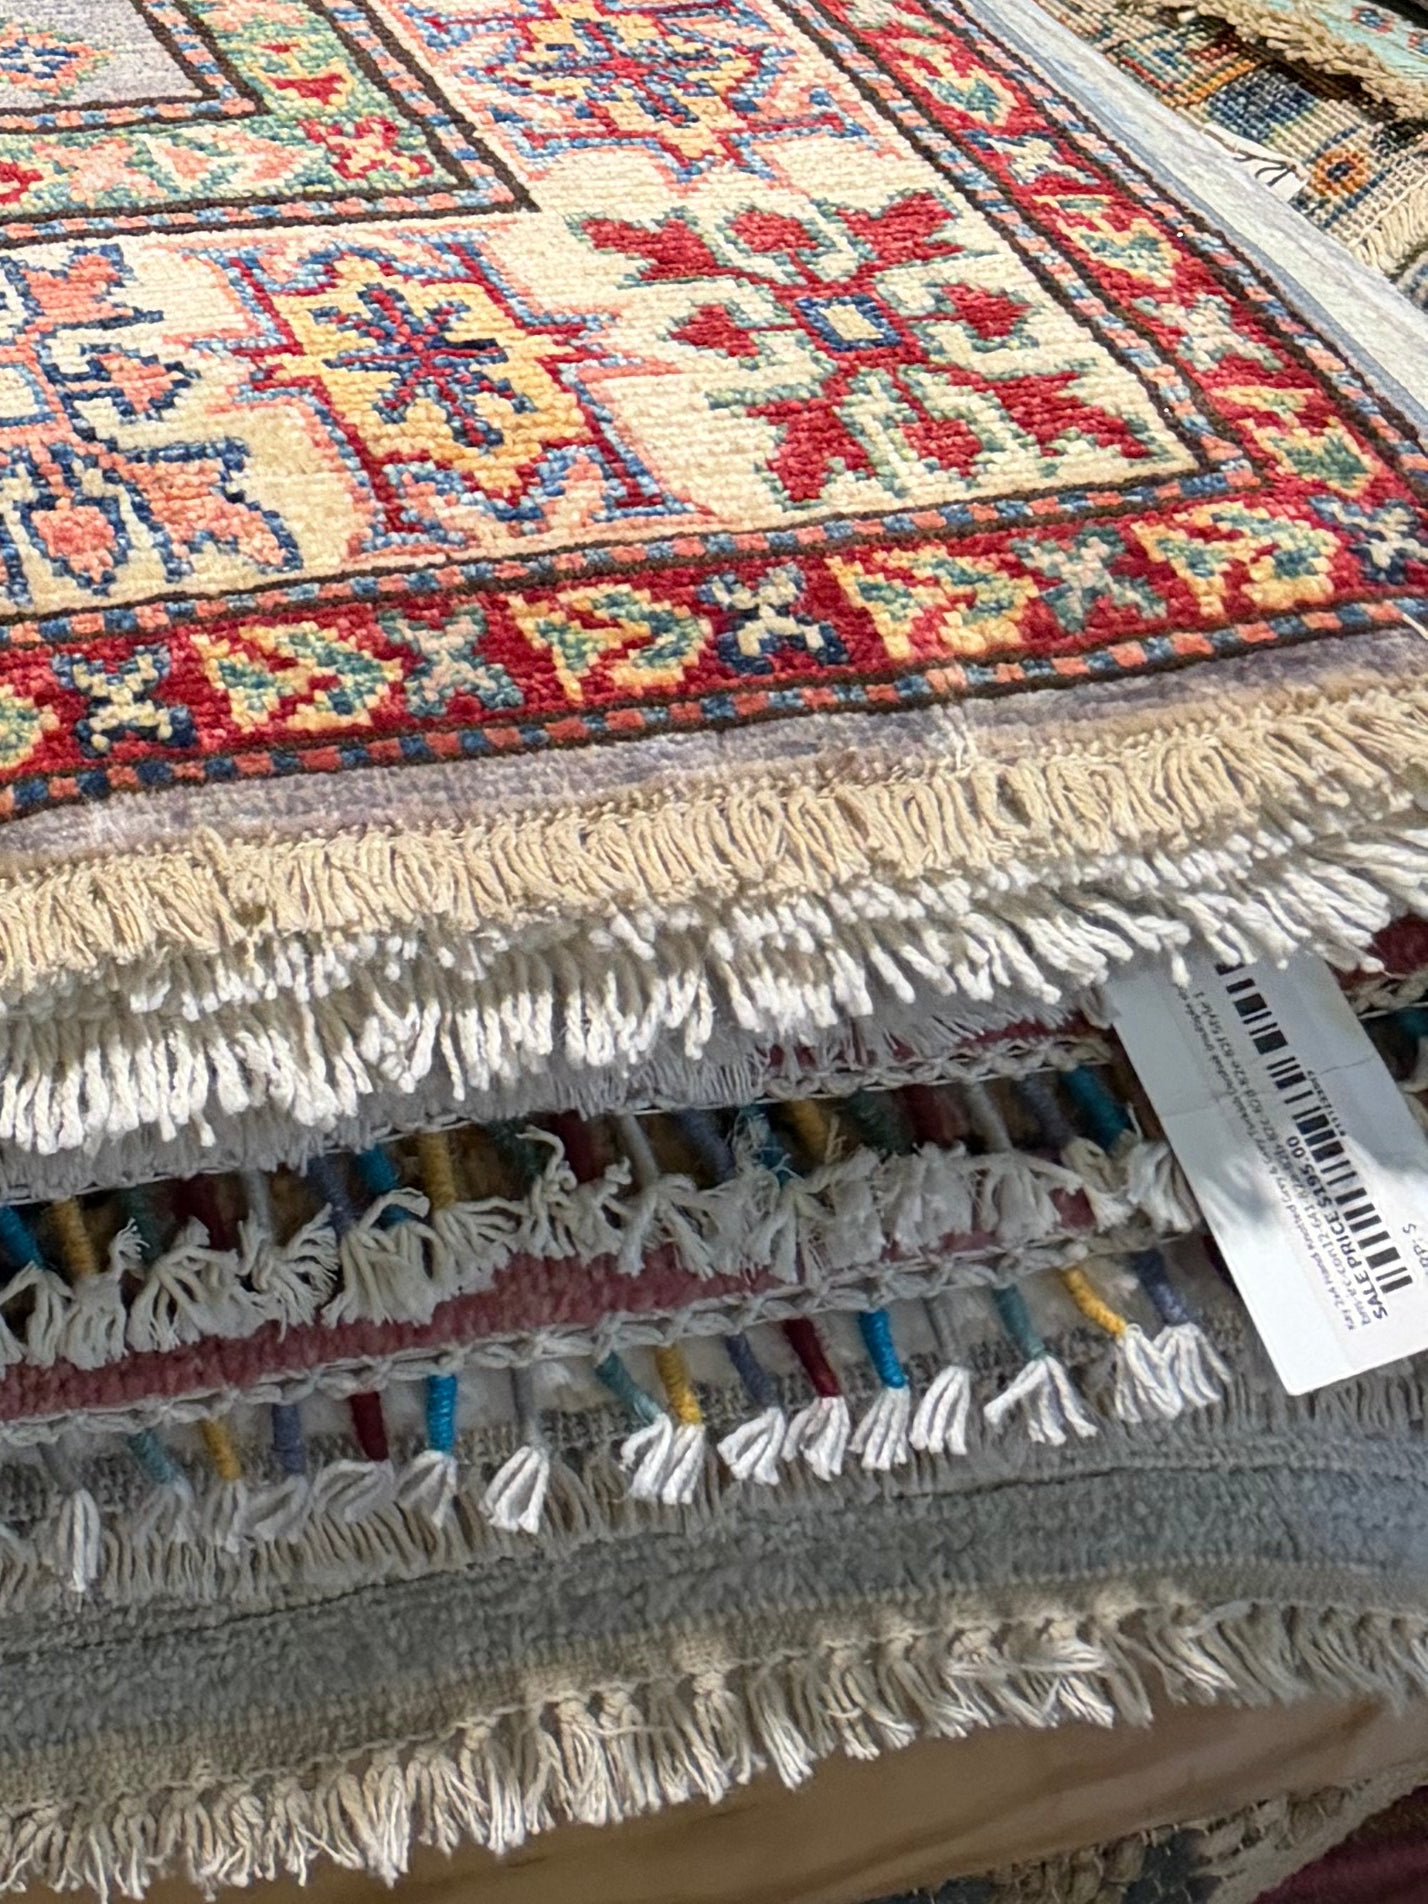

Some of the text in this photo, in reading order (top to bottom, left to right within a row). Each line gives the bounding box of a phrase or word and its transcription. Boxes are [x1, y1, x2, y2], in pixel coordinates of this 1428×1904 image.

[1286, 1135, 1332, 1208] $195.00
[1285, 1203, 1315, 1250] Knotted
[1323, 1210, 1362, 1269] PRICE
[1353, 1270, 1388, 1319] SALE
